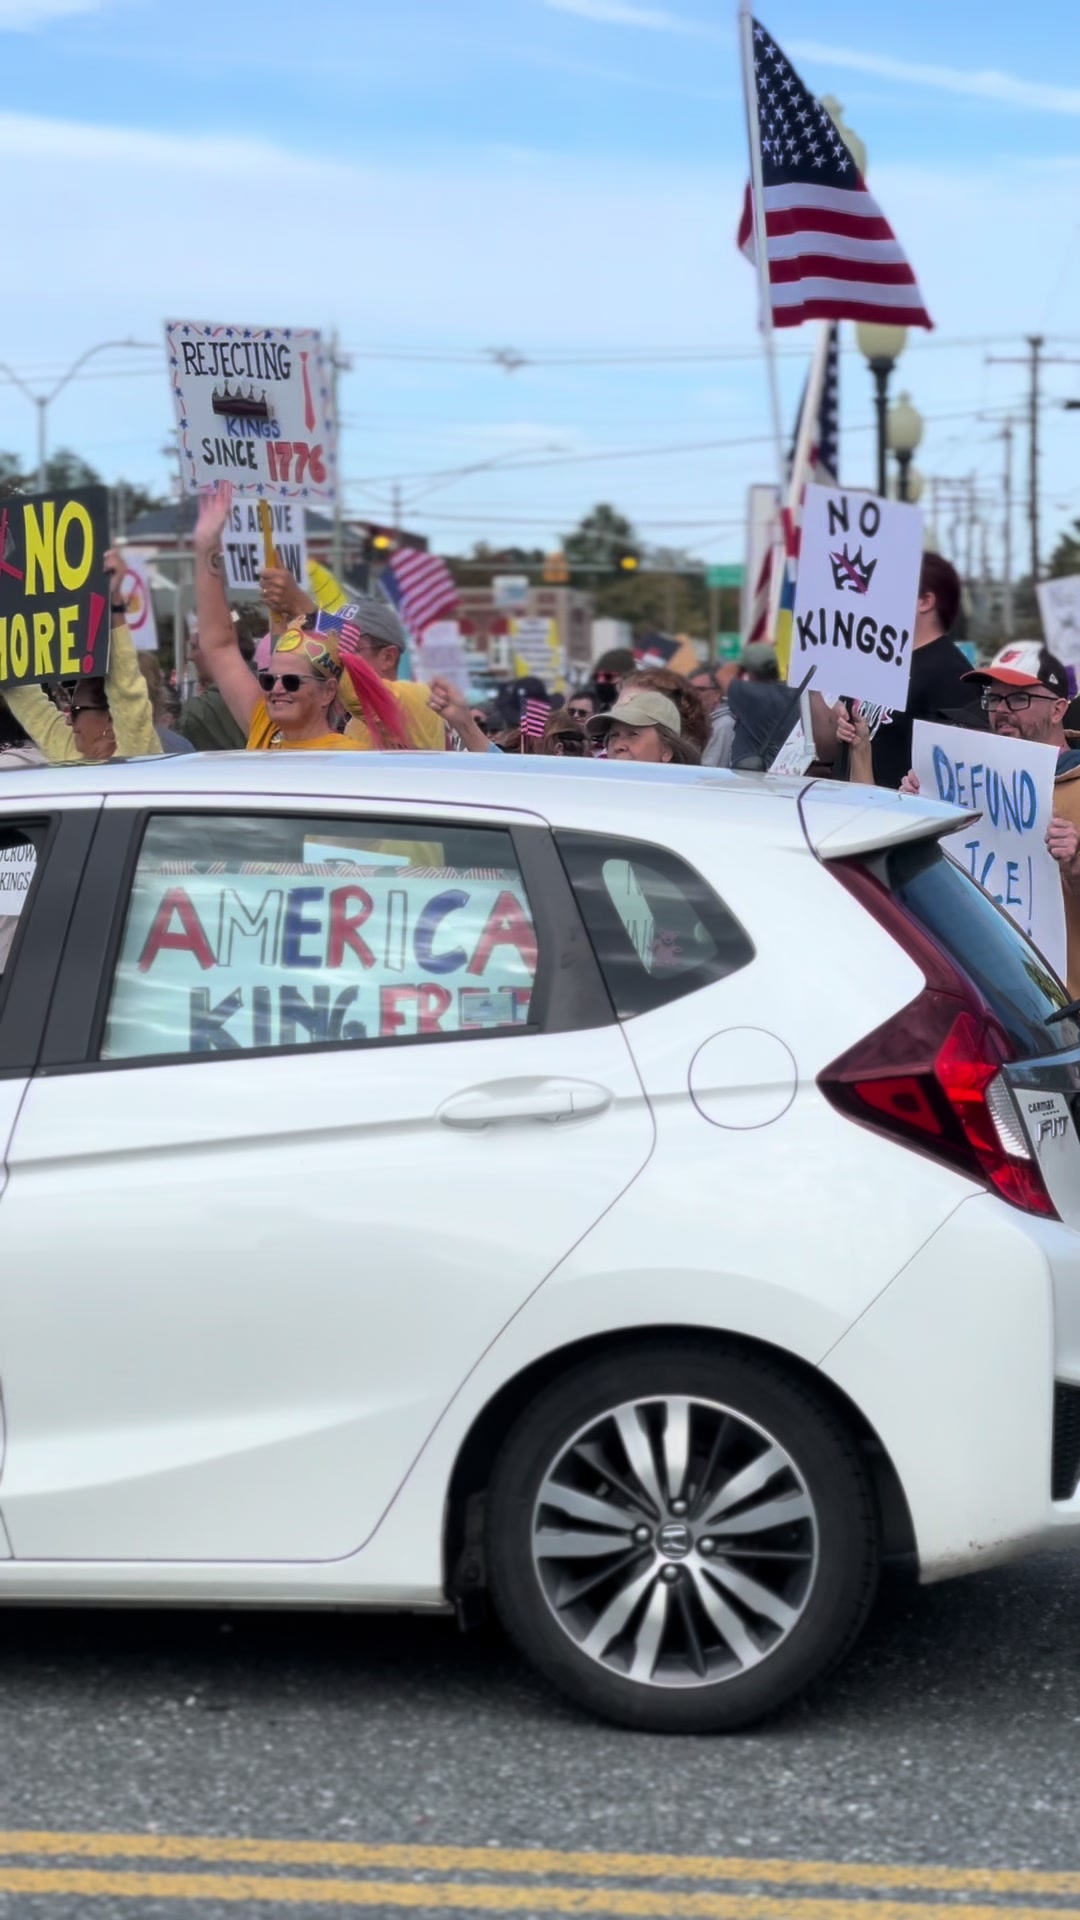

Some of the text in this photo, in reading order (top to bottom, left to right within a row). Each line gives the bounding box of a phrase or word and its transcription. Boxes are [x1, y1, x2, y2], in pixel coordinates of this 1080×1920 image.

[181, 341, 292, 381] REJECTING
[227, 417, 281, 439] KINGS
[202, 437, 327, 484] SINCE 1776
[828, 496, 880, 538] NO
[23, 500, 94, 596] NO
[226, 543, 260, 583] THE
[797, 607, 909, 667] KINGS!
[932, 744, 1037, 835] DEFUND
[0, 871, 31, 891] KINGS
[138, 885, 537, 976] AMERICA
[190, 984, 367, 1052] KING
